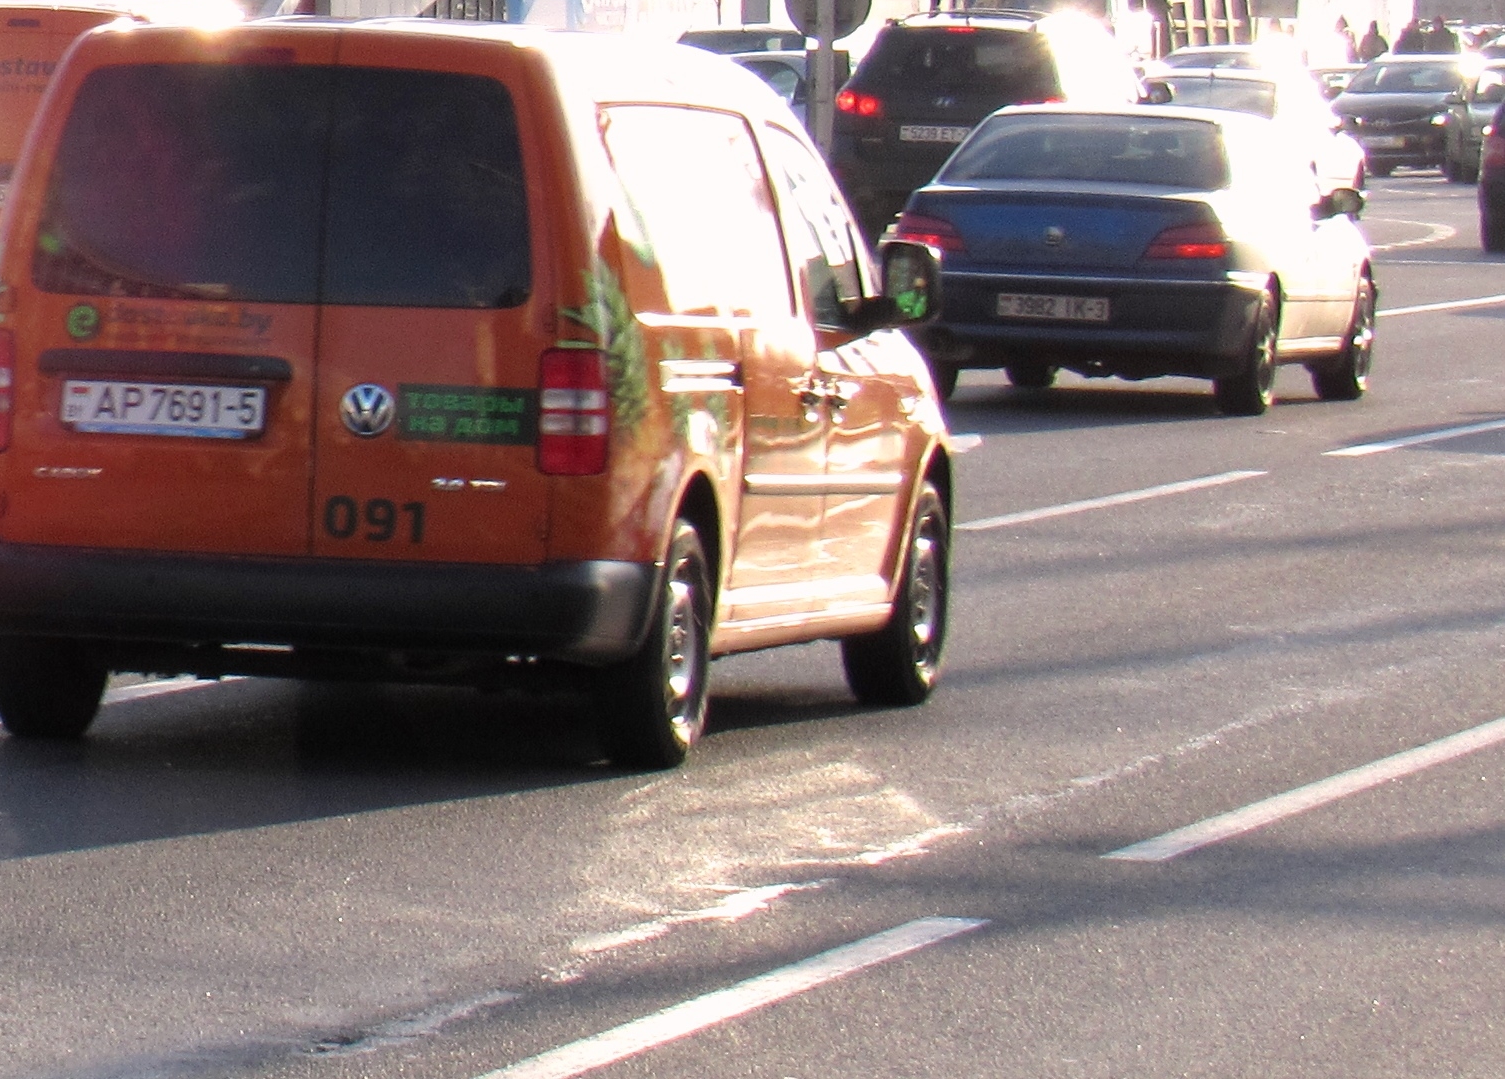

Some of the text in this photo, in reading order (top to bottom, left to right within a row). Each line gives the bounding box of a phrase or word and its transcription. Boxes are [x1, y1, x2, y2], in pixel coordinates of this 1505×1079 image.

[408, 392, 525, 417] товары
[410, 415, 520, 436] на дом
[324, 495, 427, 544] 091
